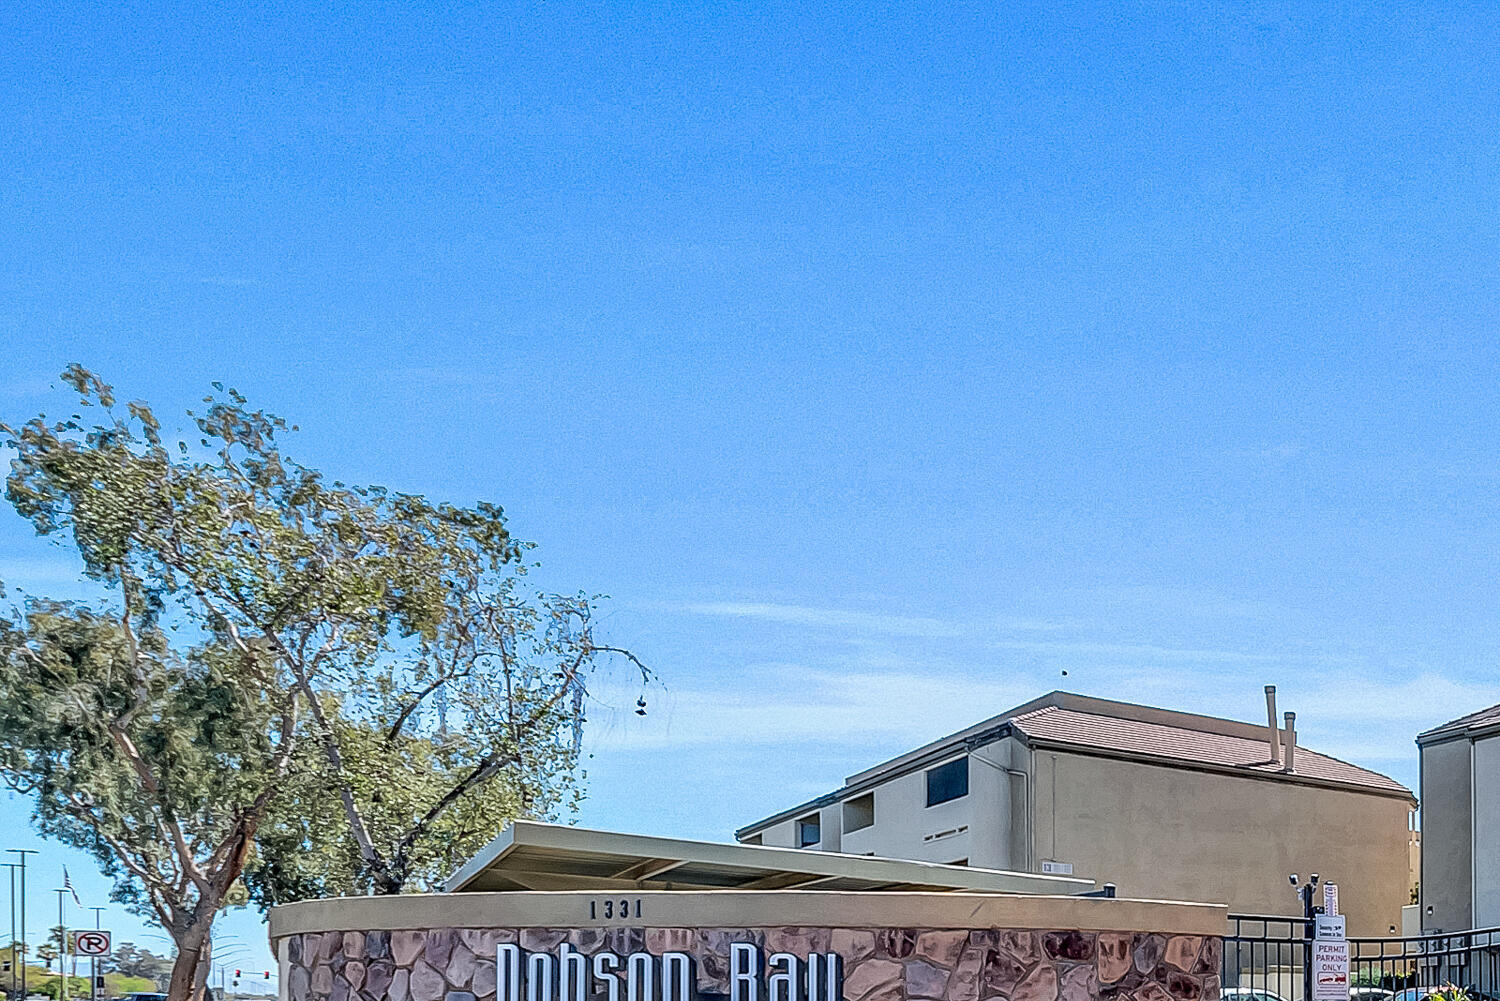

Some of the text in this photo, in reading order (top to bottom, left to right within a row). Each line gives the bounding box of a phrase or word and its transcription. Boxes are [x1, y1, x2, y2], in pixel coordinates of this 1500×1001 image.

[590, 899, 642, 920] 1331
[1318, 945, 1345, 953] PERMIT
[1315, 954, 1348, 963] PARKING
